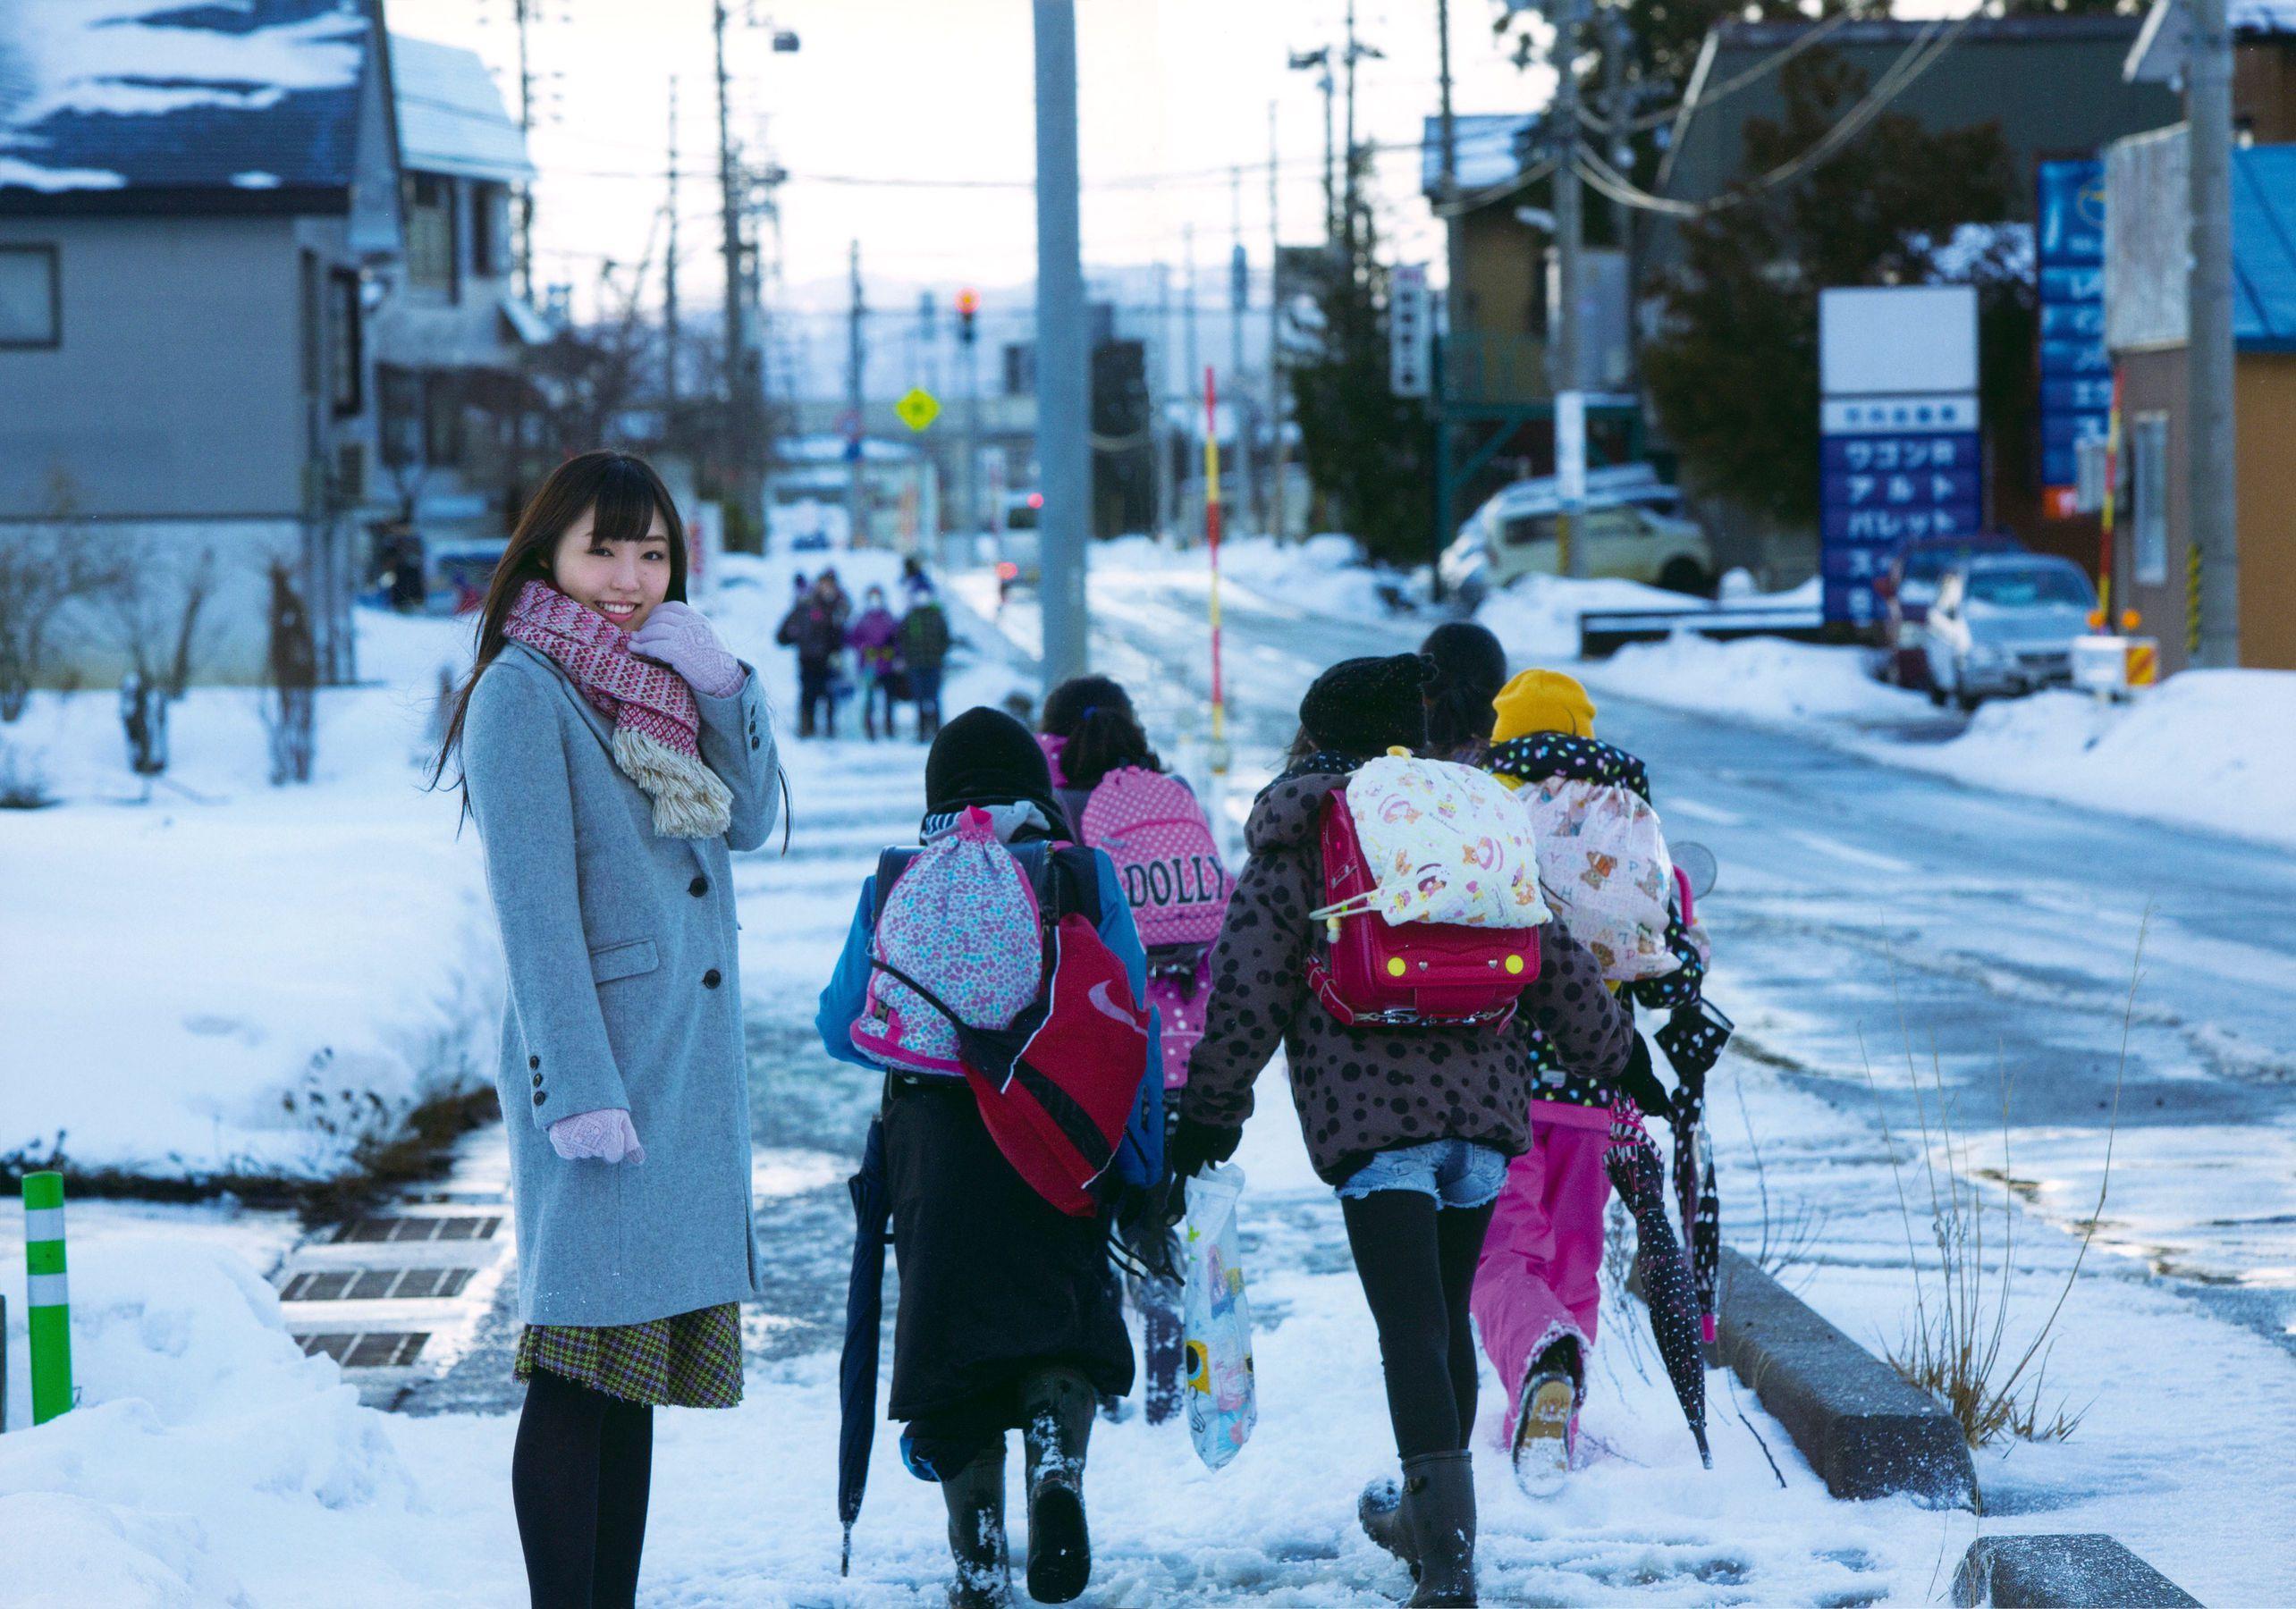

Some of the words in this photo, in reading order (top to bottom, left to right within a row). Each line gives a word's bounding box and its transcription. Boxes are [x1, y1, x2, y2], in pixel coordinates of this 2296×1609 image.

[1846, 474, 1957, 505] アルト
[1123, 855, 1225, 908] DOLLY
